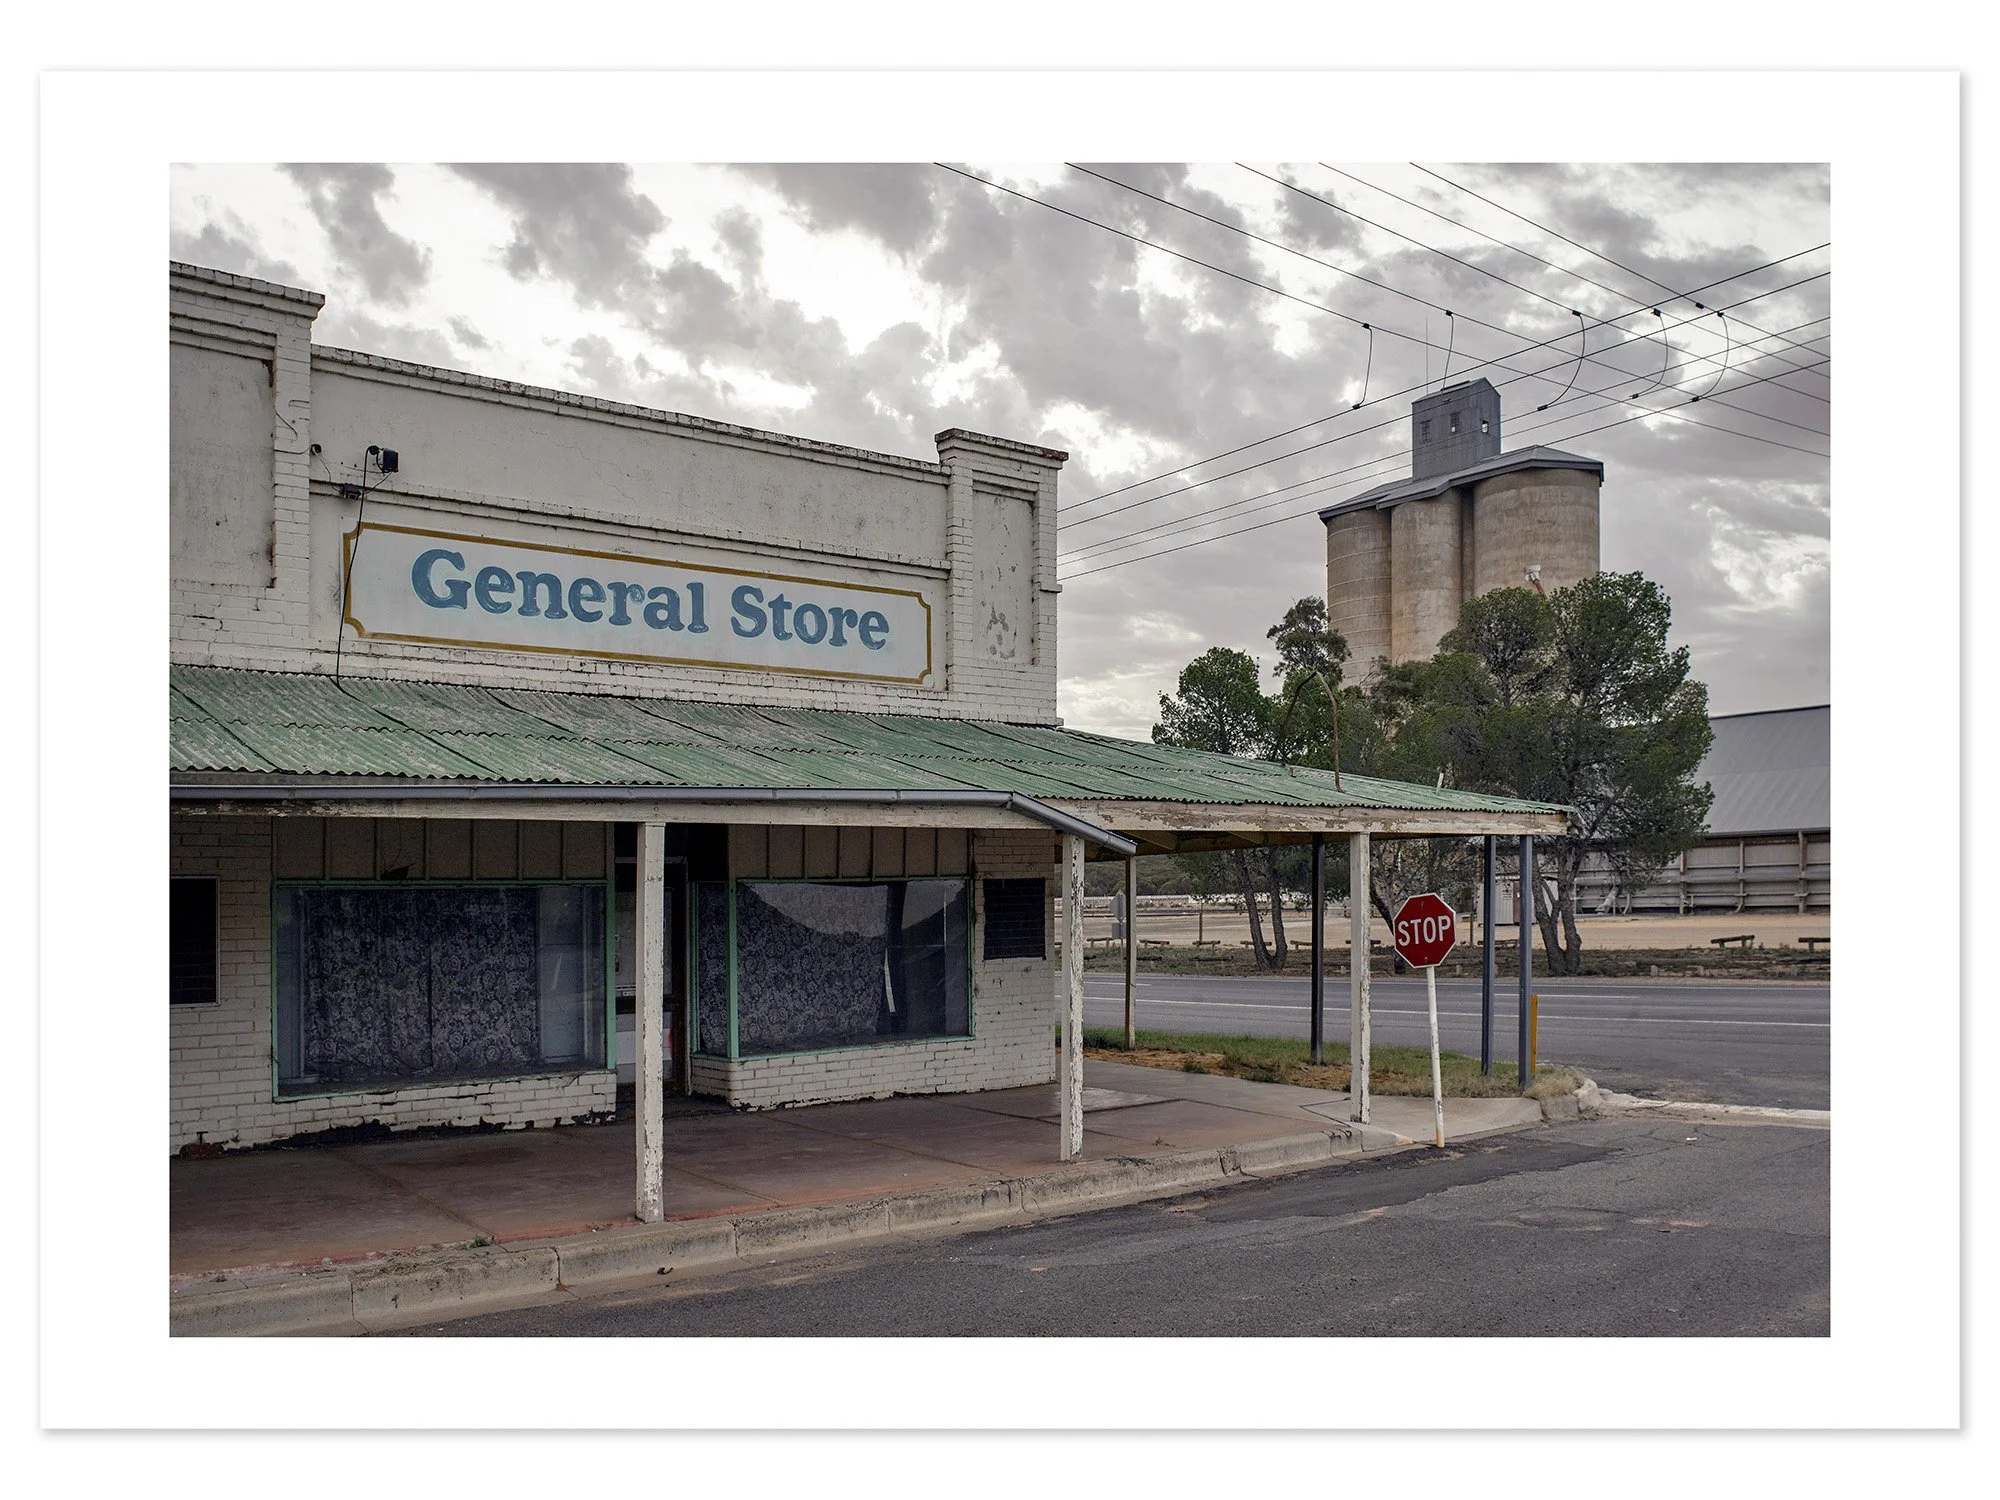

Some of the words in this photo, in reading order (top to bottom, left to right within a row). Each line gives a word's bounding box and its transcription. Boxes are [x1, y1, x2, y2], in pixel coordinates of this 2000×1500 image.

[411, 549, 709, 633] General
[731, 585, 890, 650] Store
[1398, 915, 1451, 946] STOP
